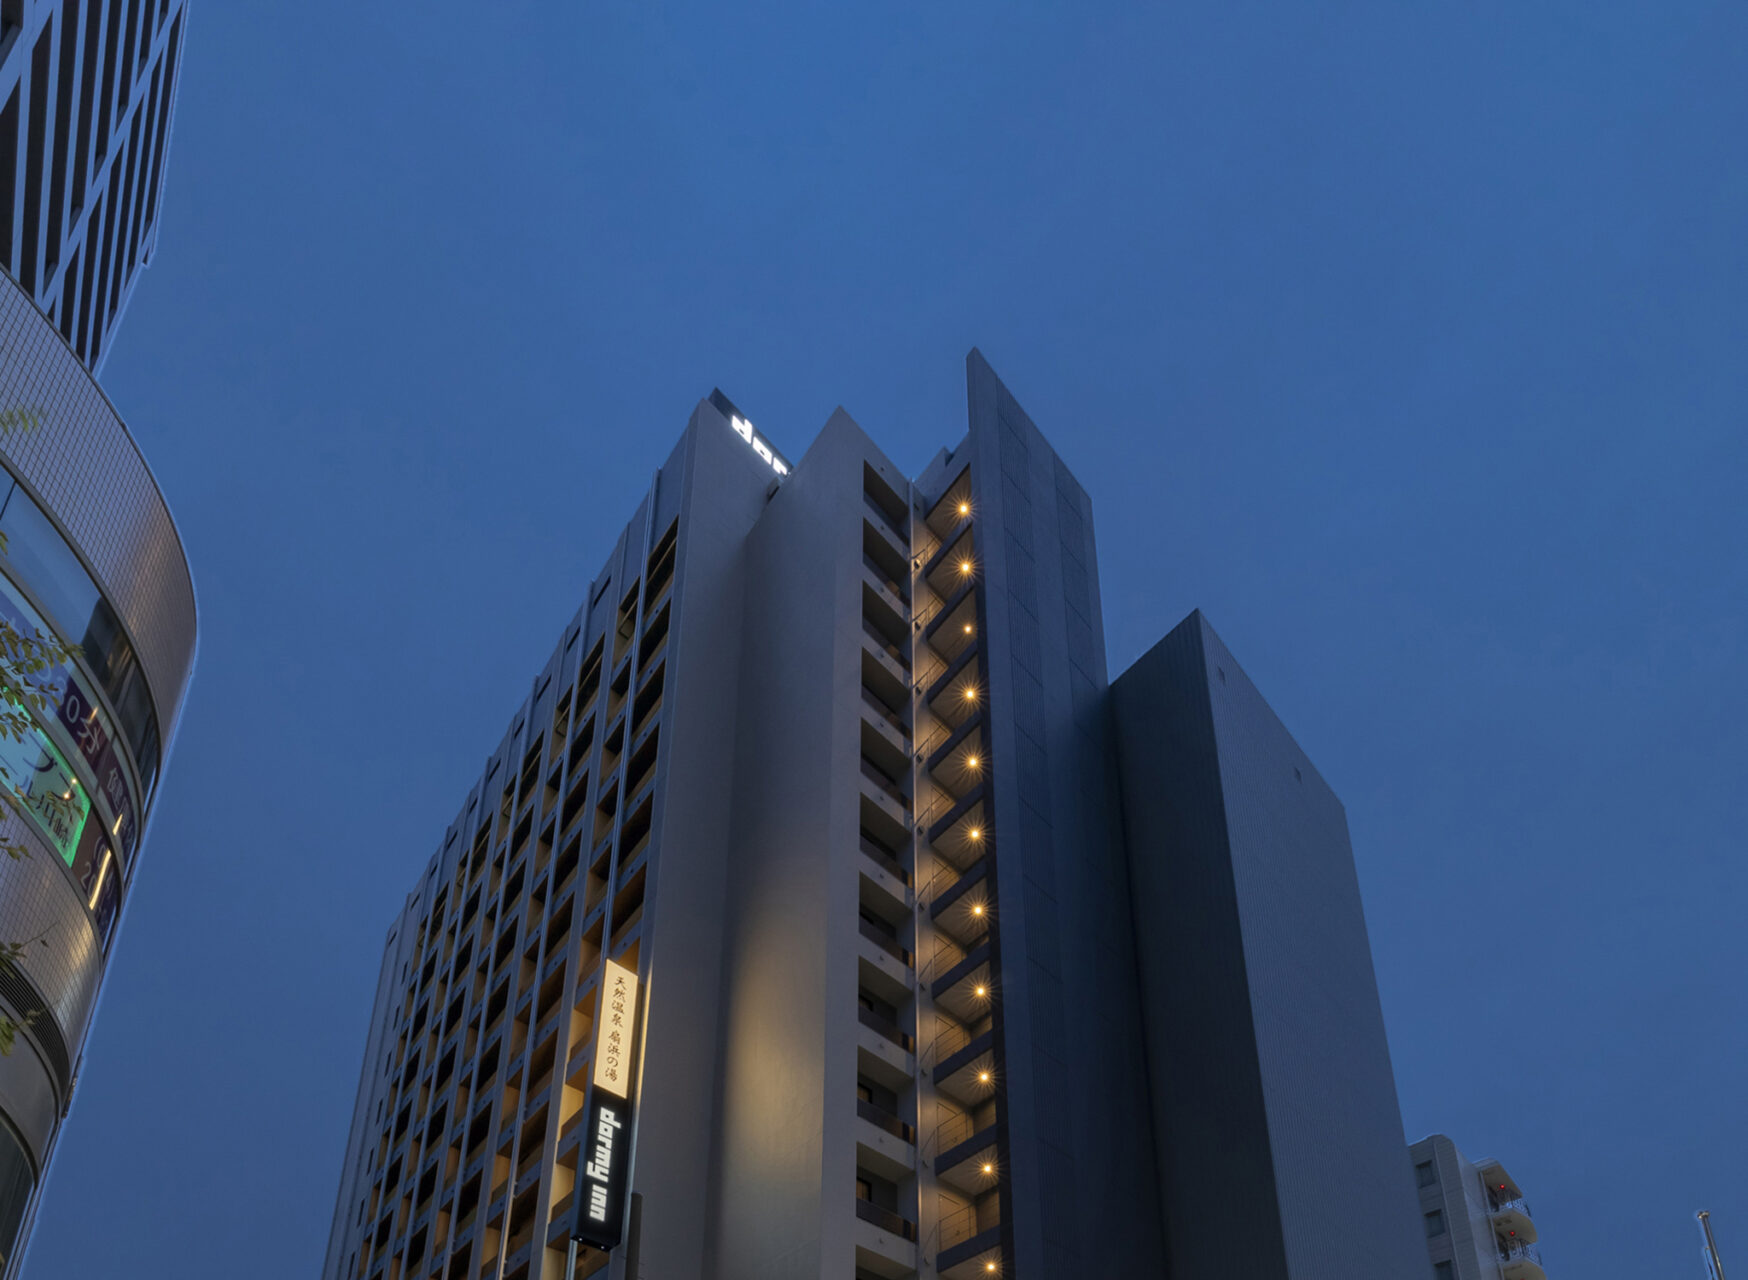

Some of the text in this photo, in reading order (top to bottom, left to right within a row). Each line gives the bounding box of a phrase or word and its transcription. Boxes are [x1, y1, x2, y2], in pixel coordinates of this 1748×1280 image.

[610, 975, 627, 1029] 天然温泉
[586, 1107, 622, 1223] dormy inn
